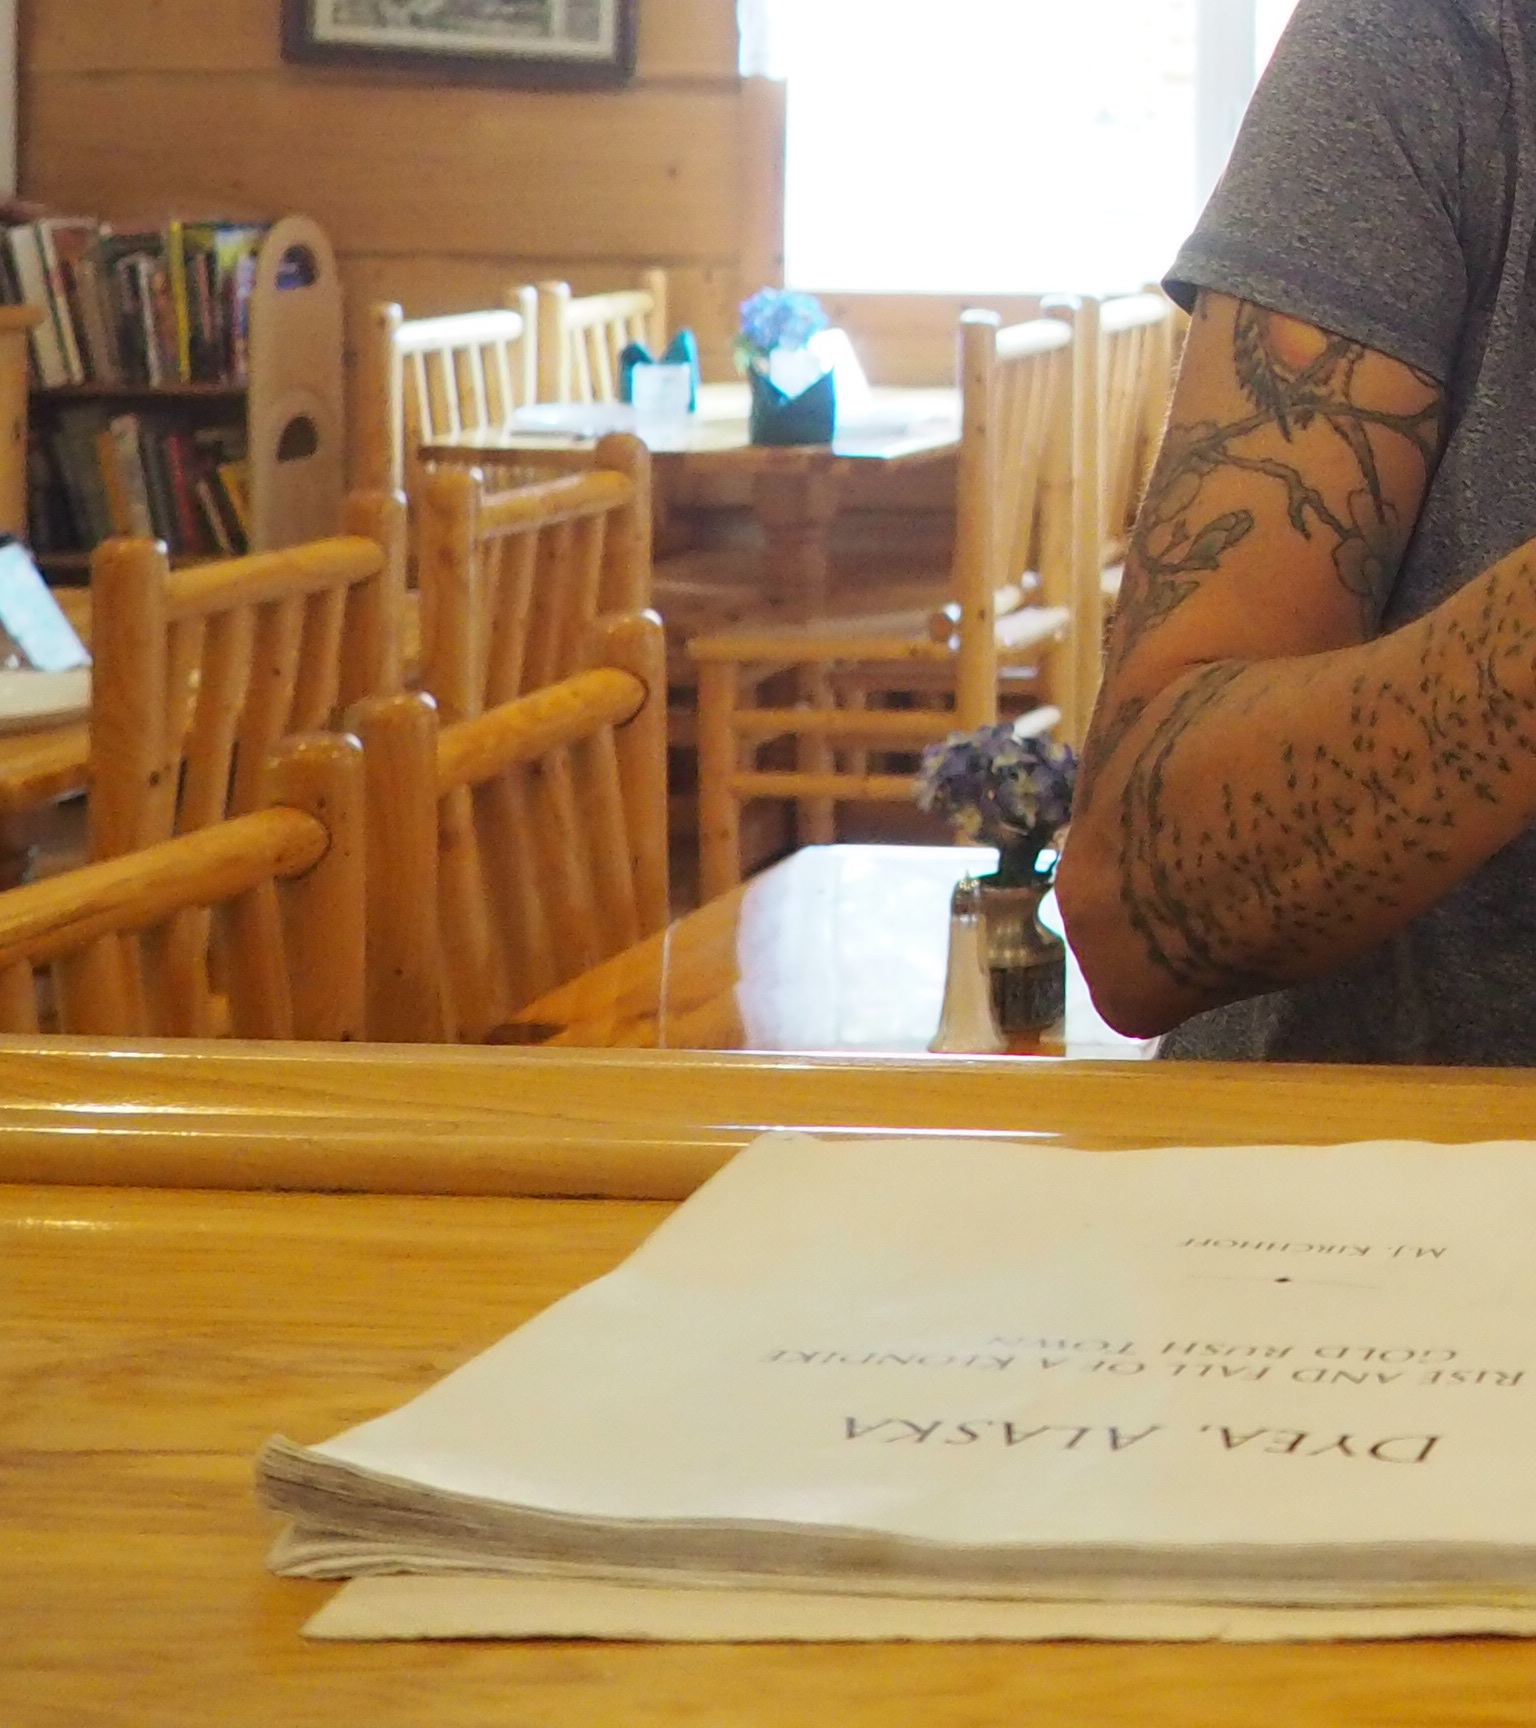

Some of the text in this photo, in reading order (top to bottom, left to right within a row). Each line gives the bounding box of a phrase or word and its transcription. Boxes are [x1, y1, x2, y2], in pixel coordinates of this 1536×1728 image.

[980, 1334, 1458, 1365] GOLD RUSH TOWN
[755, 1349, 1016, 1372] KLONDIKE
[1041, 1357, 1072, 1371] A
[1078, 1360, 1148, 1377] OF
[1164, 1362, 1272, 1383] FALL
[1292, 1367, 1404, 1386] AND
[1418, 1369, 1526, 1389] RISE
[845, 1416, 1166, 1452] ALASKA
